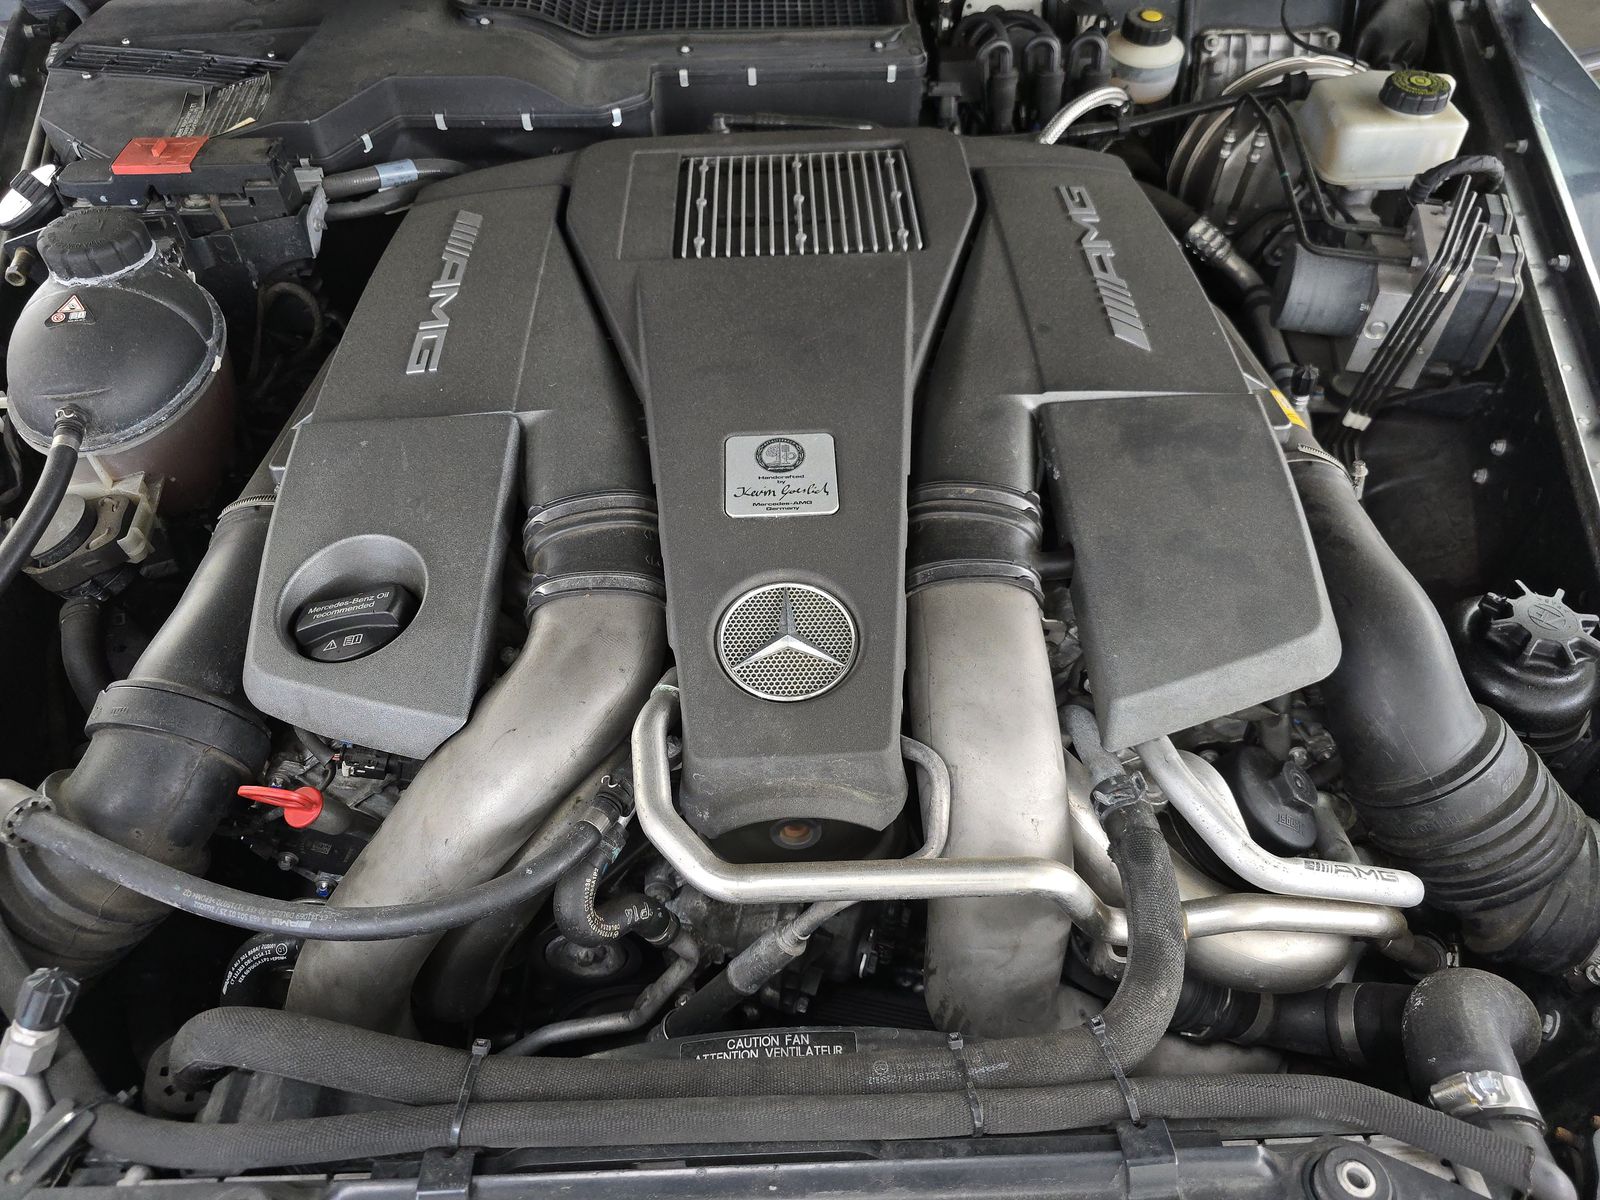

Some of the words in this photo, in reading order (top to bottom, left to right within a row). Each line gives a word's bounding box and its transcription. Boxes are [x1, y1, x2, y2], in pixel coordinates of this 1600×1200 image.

[406, 252, 468, 375] AMG
[307, 595, 375, 615] Mercedes-Benz
[376, 591, 390, 600] Oil
[312, 601, 376, 620] recommended
[727, 1035, 779, 1050] CAUTION
[785, 1034, 809, 1046] FAN
